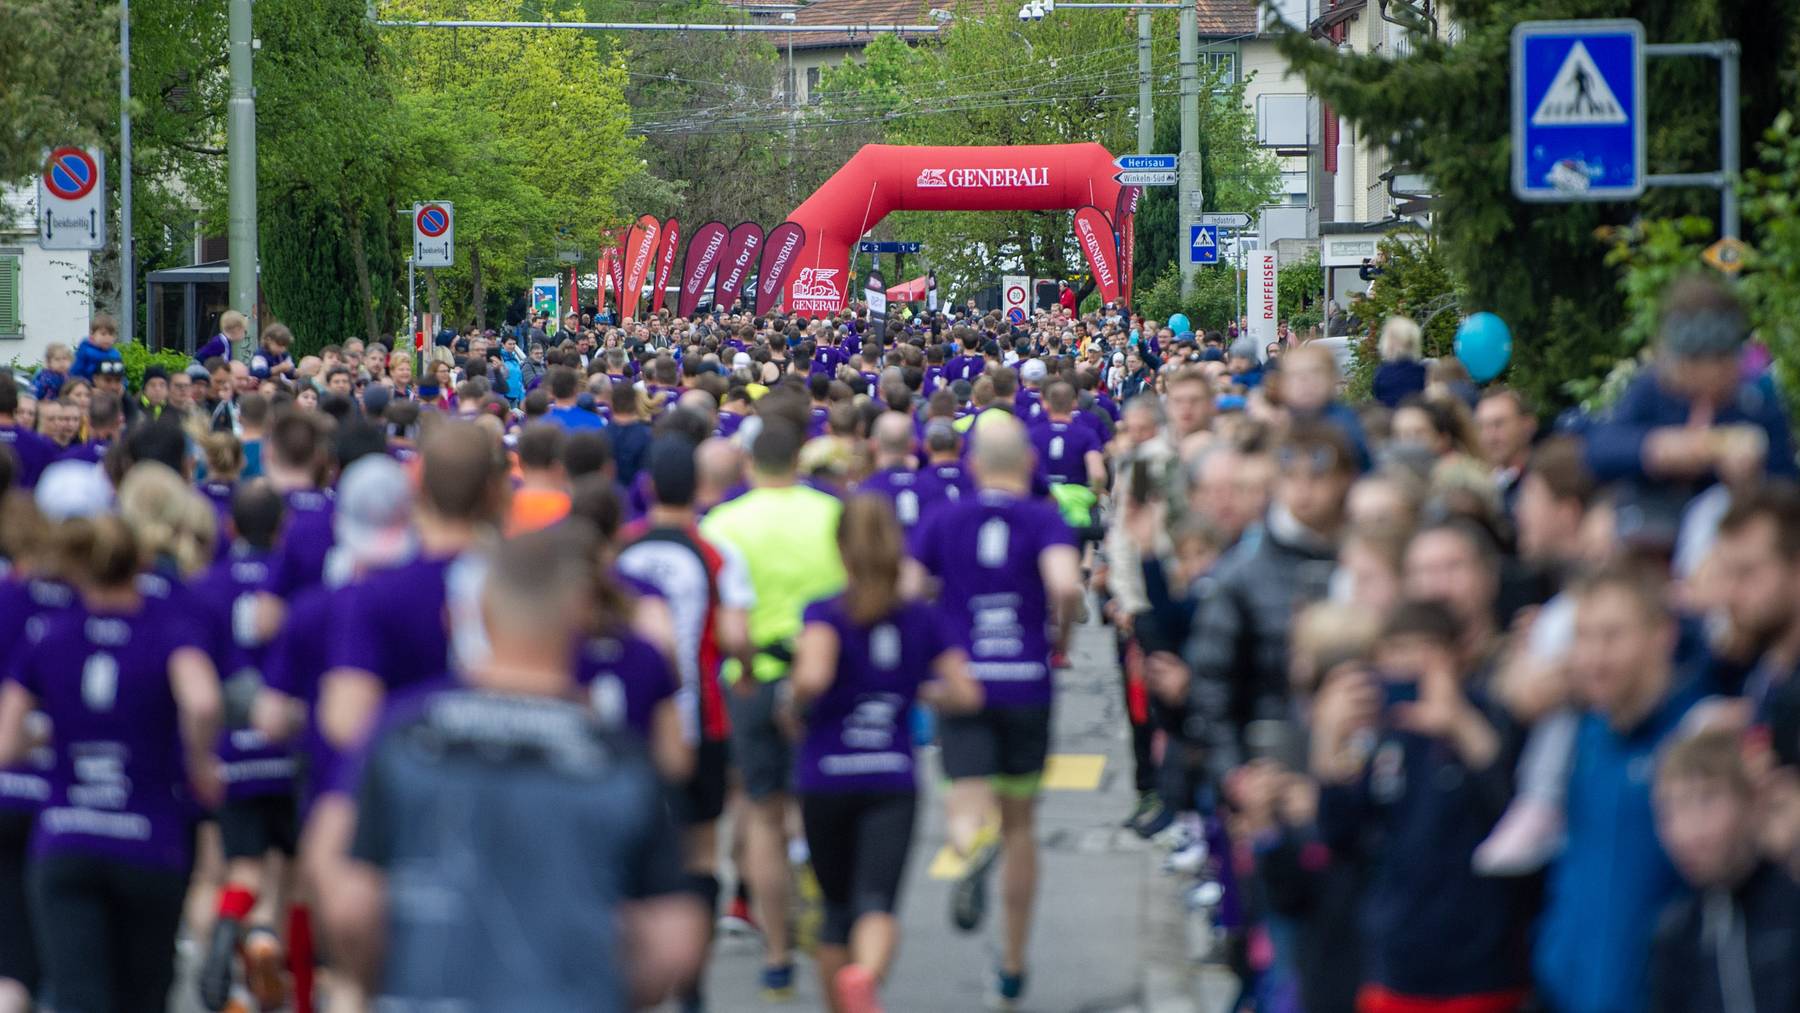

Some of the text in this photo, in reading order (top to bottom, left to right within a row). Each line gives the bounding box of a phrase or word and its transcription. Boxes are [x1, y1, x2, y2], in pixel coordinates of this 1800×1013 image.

[948, 167, 1050, 187] GENERALI
[1123, 174, 1166, 182] Winkeln-Süd
[1128, 158, 1165, 167] Herisau
[1211, 216, 1236, 224] Industrie
[633, 224, 657, 275] GENERALI
[694, 230, 725, 279] GENERALI
[722, 234, 758, 292] Run for it!
[770, 231, 799, 279] GENERALI
[1085, 233, 1114, 287] GENERALI
[1012, 290, 1021, 299] 30
[1264, 255, 1273, 319] RAIFFEISEN
[792, 300, 840, 311] GENERALI
